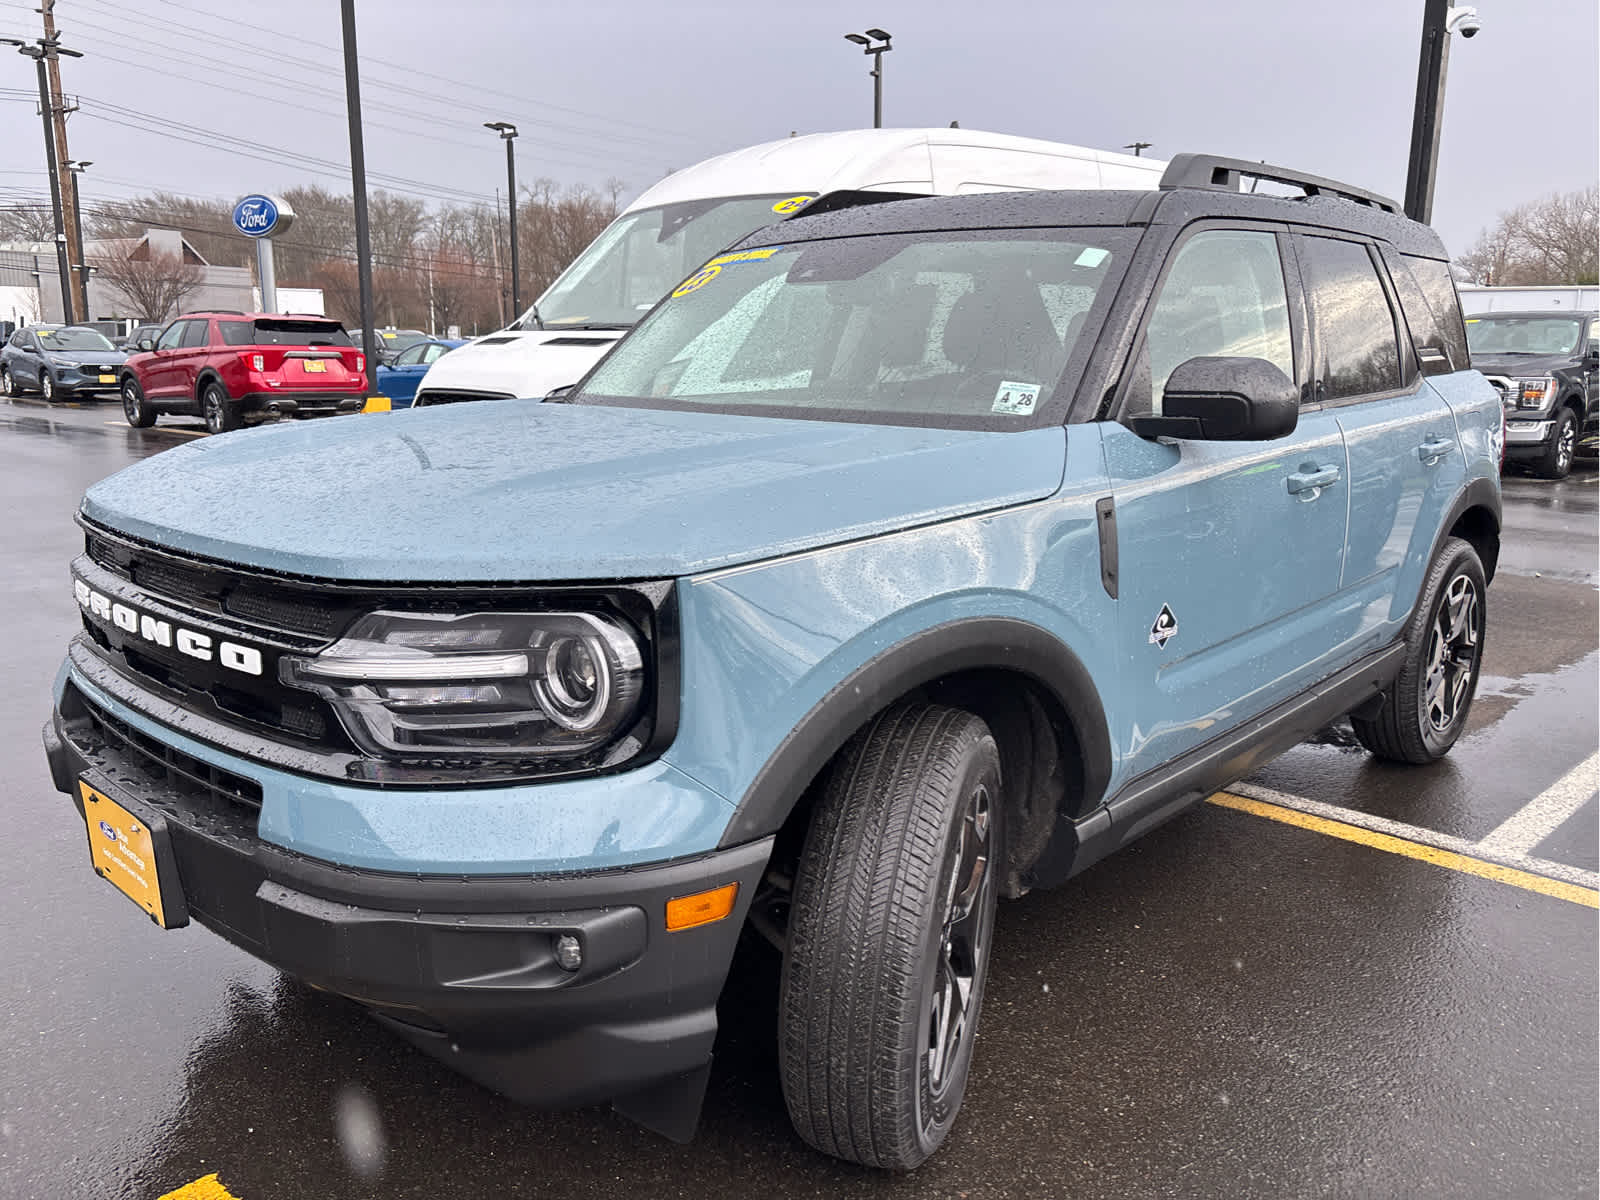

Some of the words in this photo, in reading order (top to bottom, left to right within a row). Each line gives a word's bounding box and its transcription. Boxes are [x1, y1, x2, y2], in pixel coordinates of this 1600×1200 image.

[240, 203, 269, 228] Ford
[1016, 393, 1034, 406] 28
[73, 578, 263, 676] BRONCO
